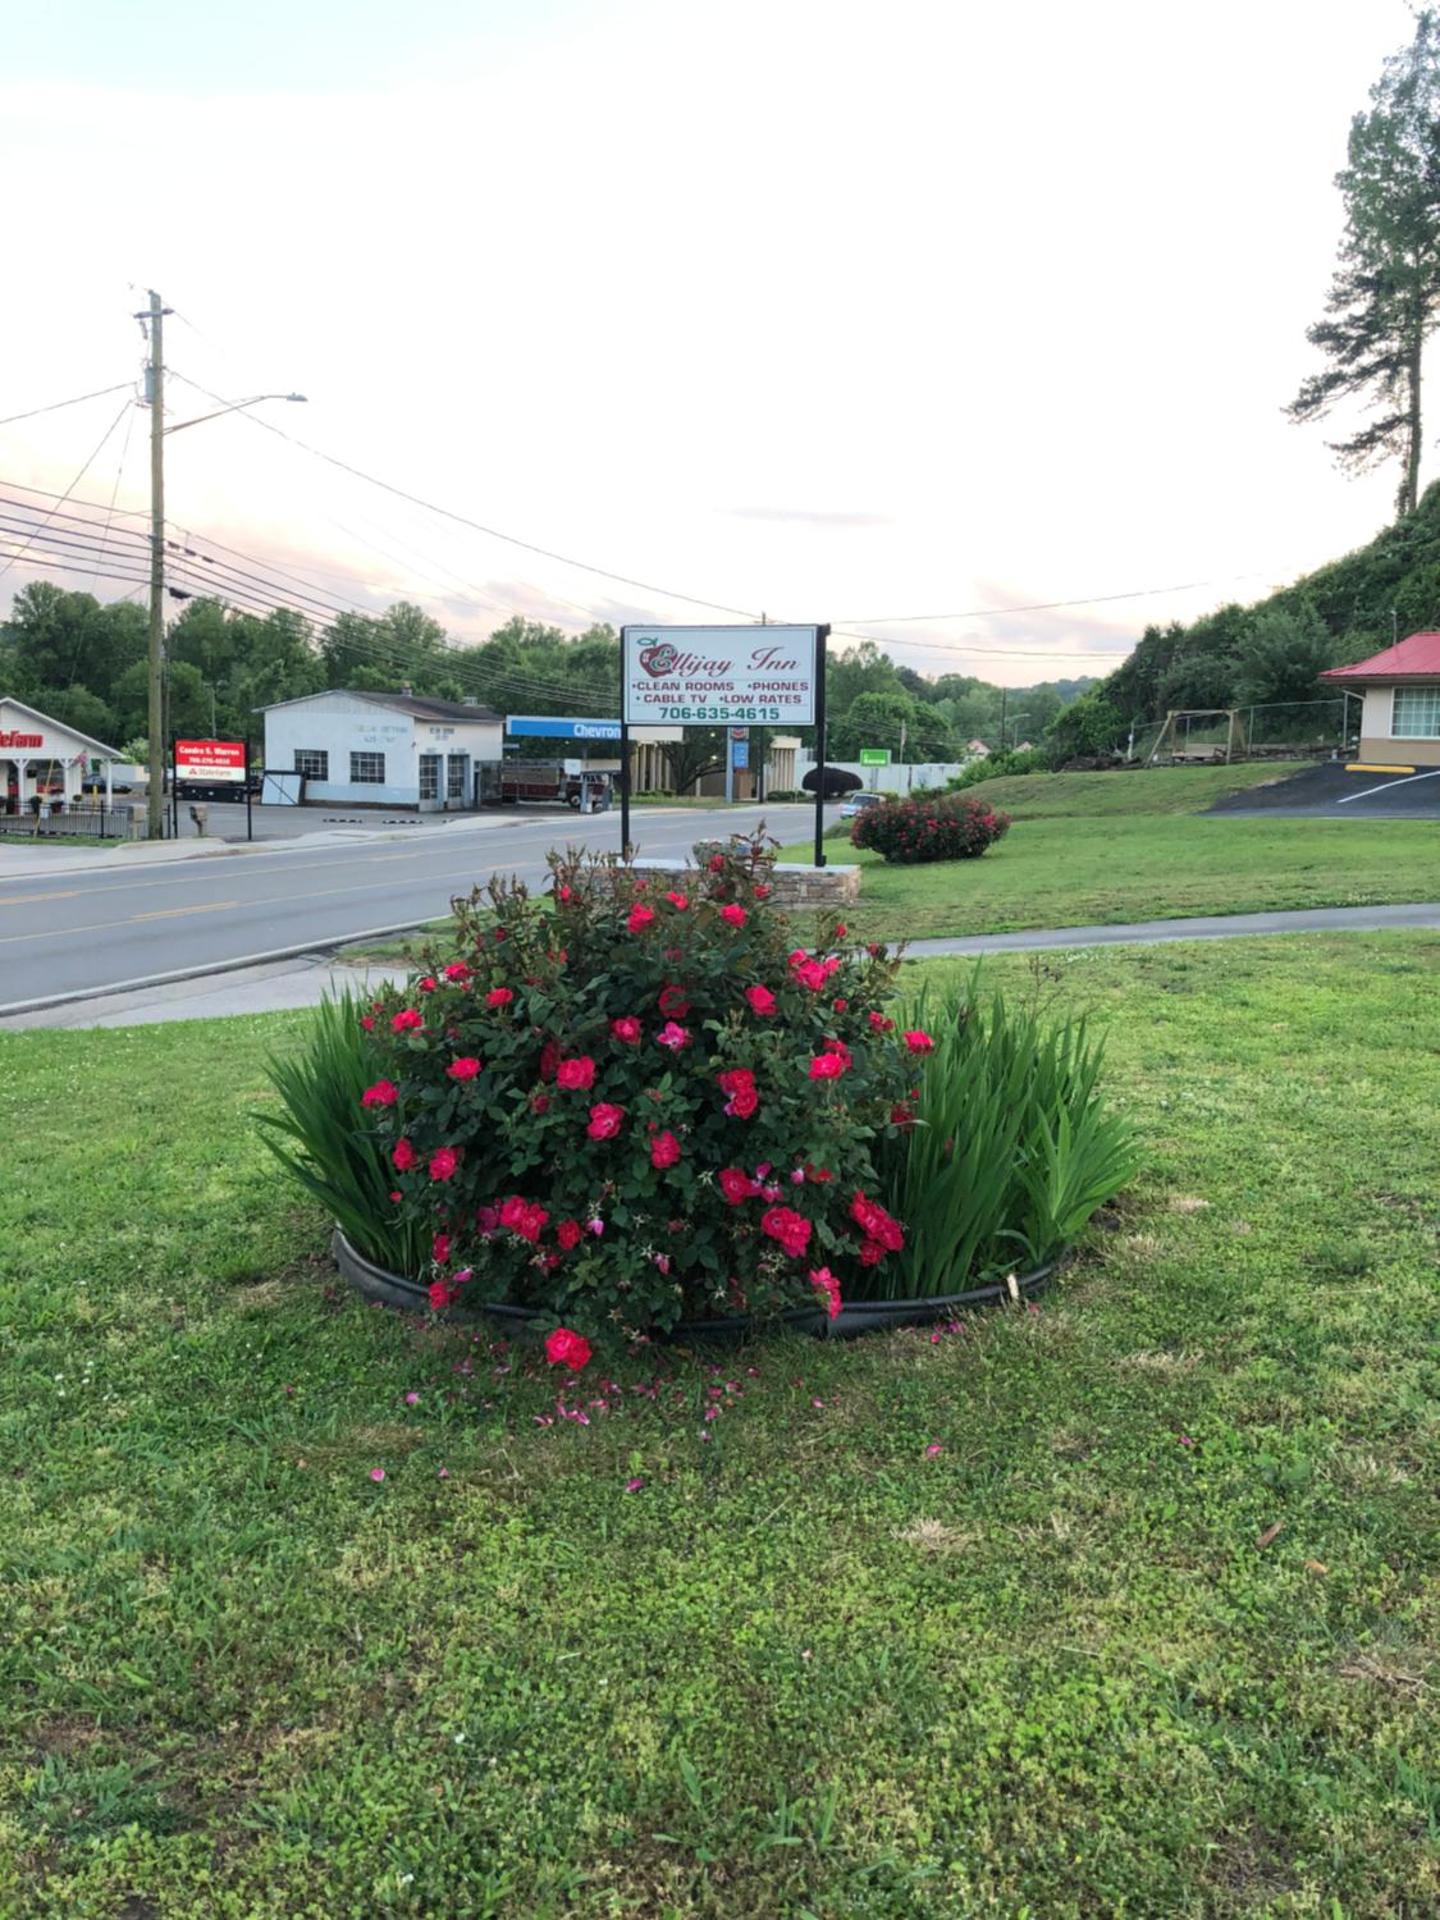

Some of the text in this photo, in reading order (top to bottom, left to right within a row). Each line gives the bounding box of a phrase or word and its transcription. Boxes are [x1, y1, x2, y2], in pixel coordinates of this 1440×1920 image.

[650, 644, 801, 677] Ellijay Inn
[637, 682, 809, 691] CLEAN ROOMS PHONES
[644, 694, 802, 704] CABLE TV LOW RATES
[659, 707, 780, 719] 706-635-4615
[574, 724, 621, 738] Chevron
